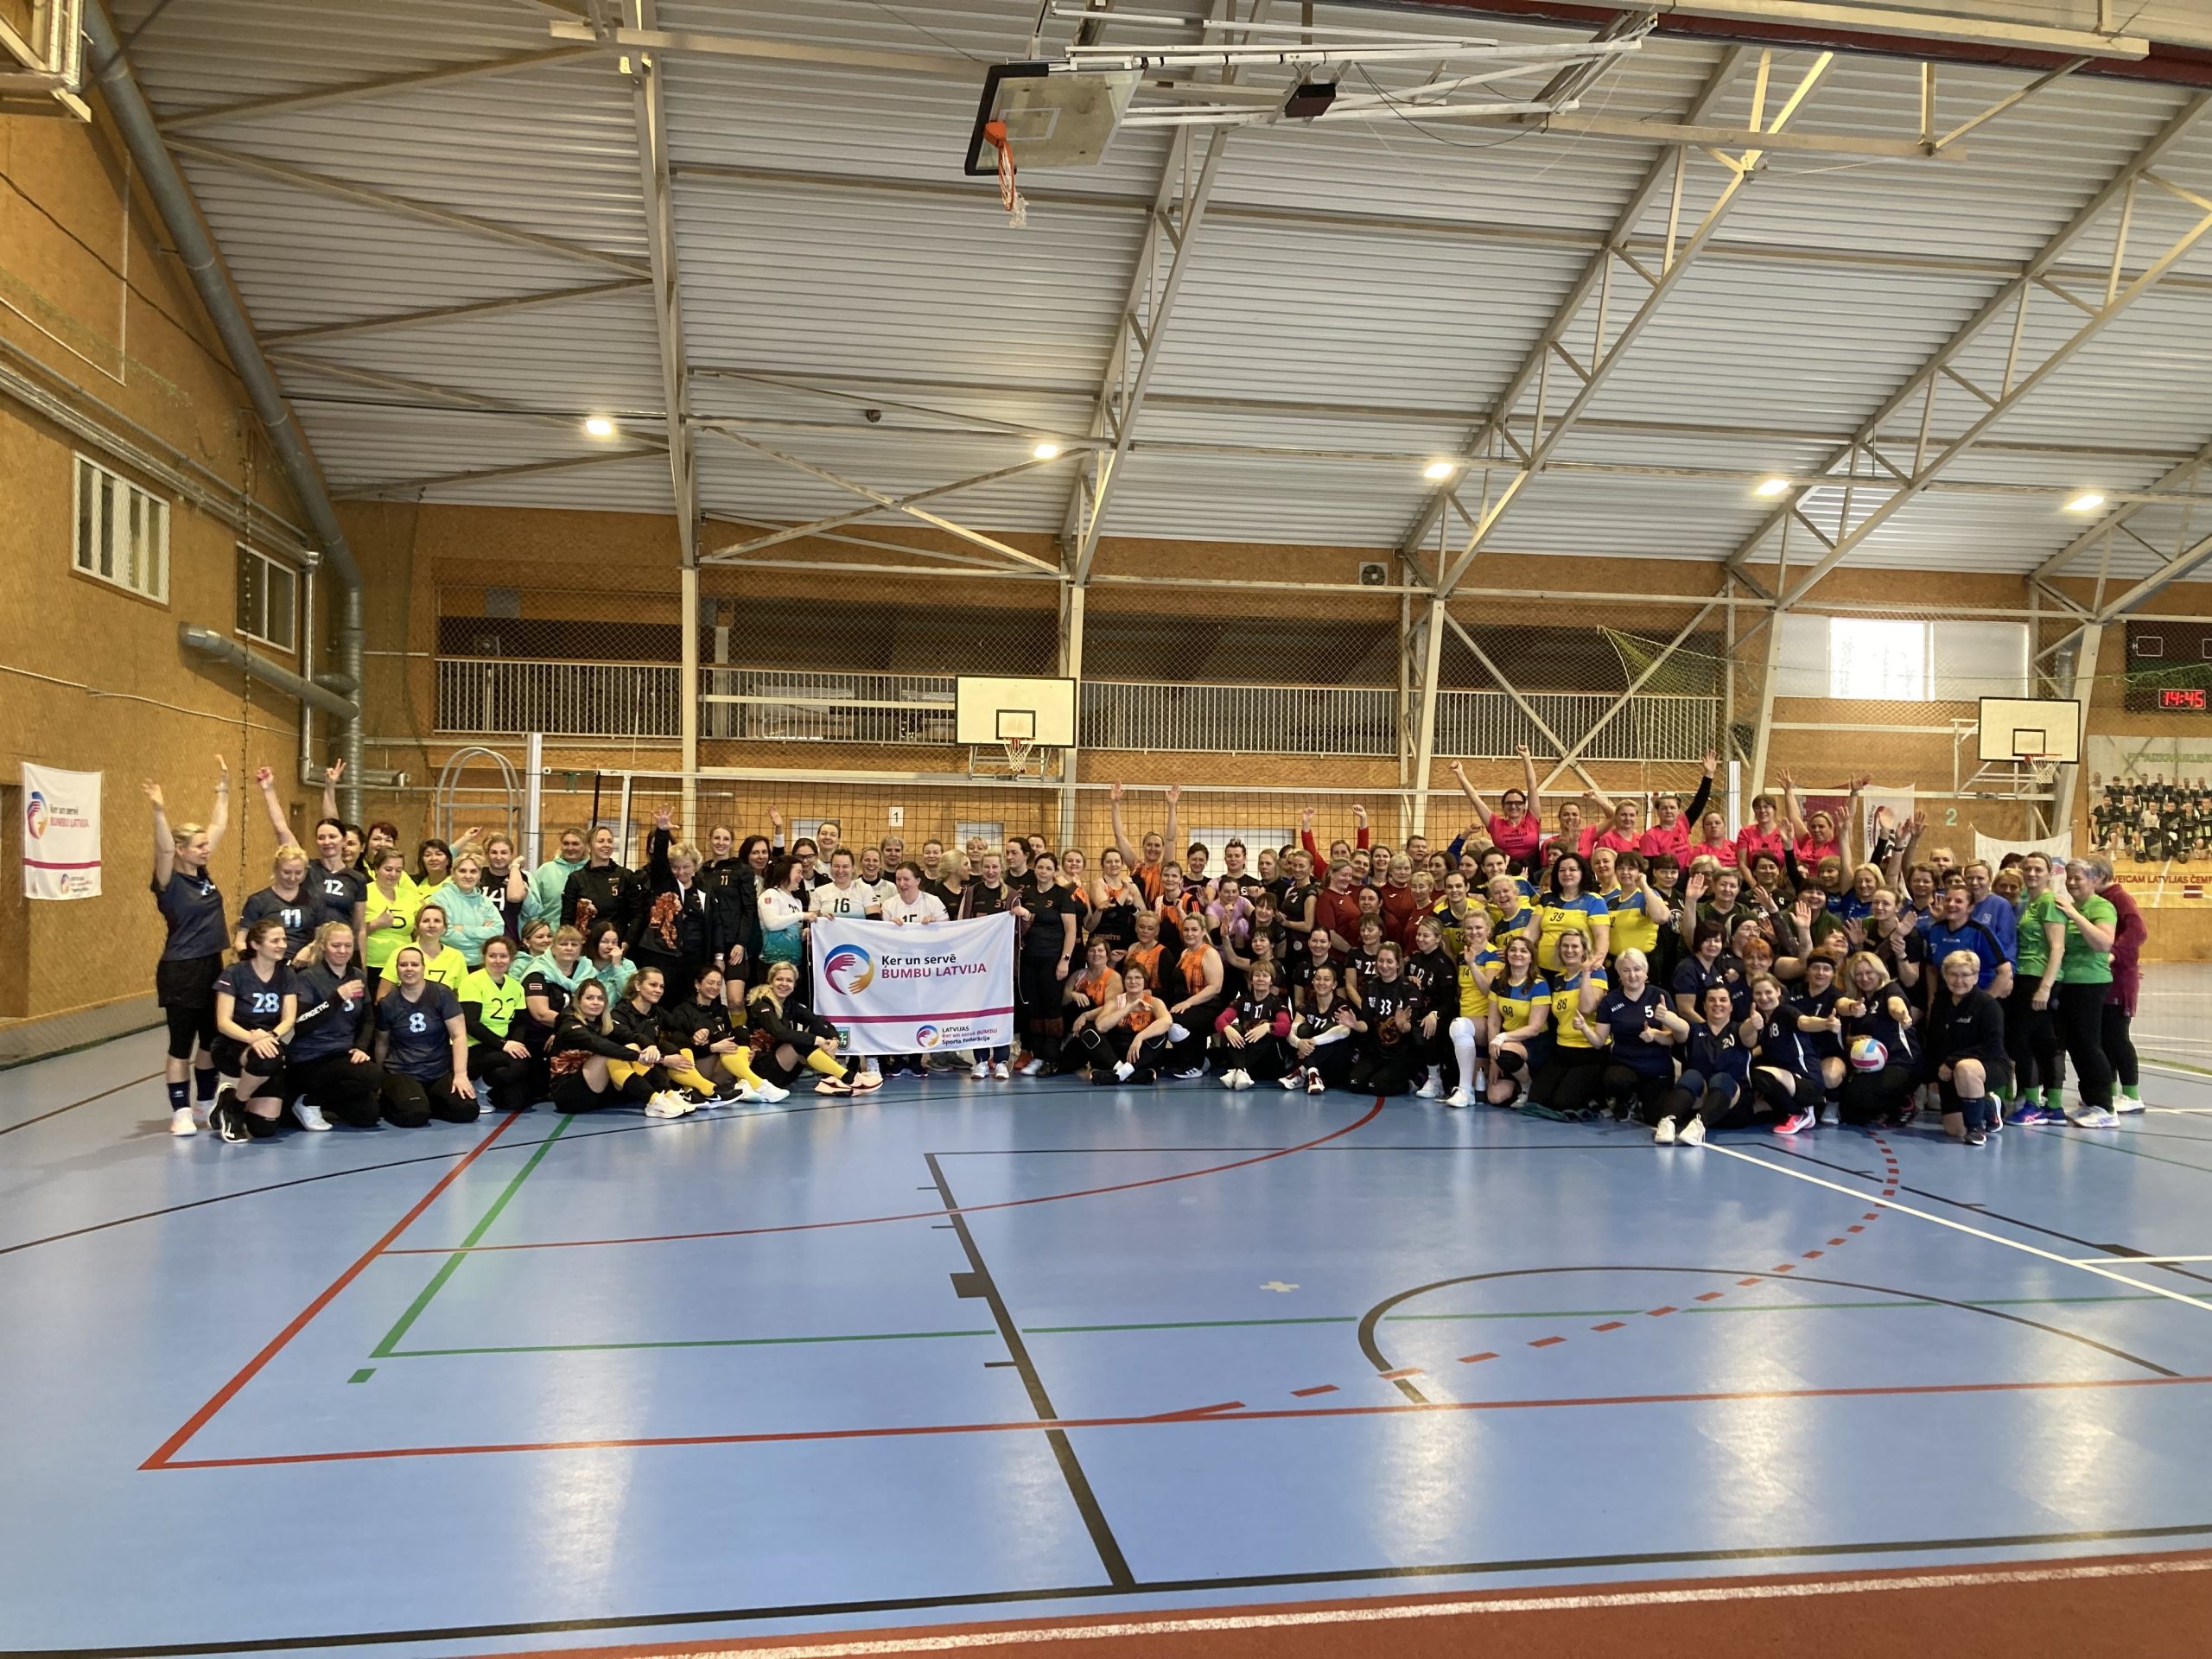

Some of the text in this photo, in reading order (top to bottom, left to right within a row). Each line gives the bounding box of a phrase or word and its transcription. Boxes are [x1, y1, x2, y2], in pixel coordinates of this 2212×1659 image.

[2164, 690, 2204, 708] 14:45
[893, 812, 899, 823] 1
[1945, 808, 1958, 826] 2
[323, 879, 345, 896] 12
[720, 875, 729, 886] 11
[611, 885, 619, 897] 5
[834, 899, 850, 913] 16
[995, 899, 1007, 910] 31
[280, 909, 302, 928] 11
[1549, 912, 1566, 922] 39
[1455, 931, 1467, 943] 32
[881, 953, 957, 969] Ķer un servē
[881, 963, 988, 979] BUMBU LATVIJA
[251, 993, 279, 1014] 28
[489, 997, 516, 1021] 22
[1254, 1003, 1263, 1019] 17
[1380, 999, 1394, 1015] 33
[1503, 1005, 1514, 1017] 99
[1556, 998, 1567, 1010] 88
[1644, 1005, 1654, 1019] 5
[409, 1012, 427, 1033] 8
